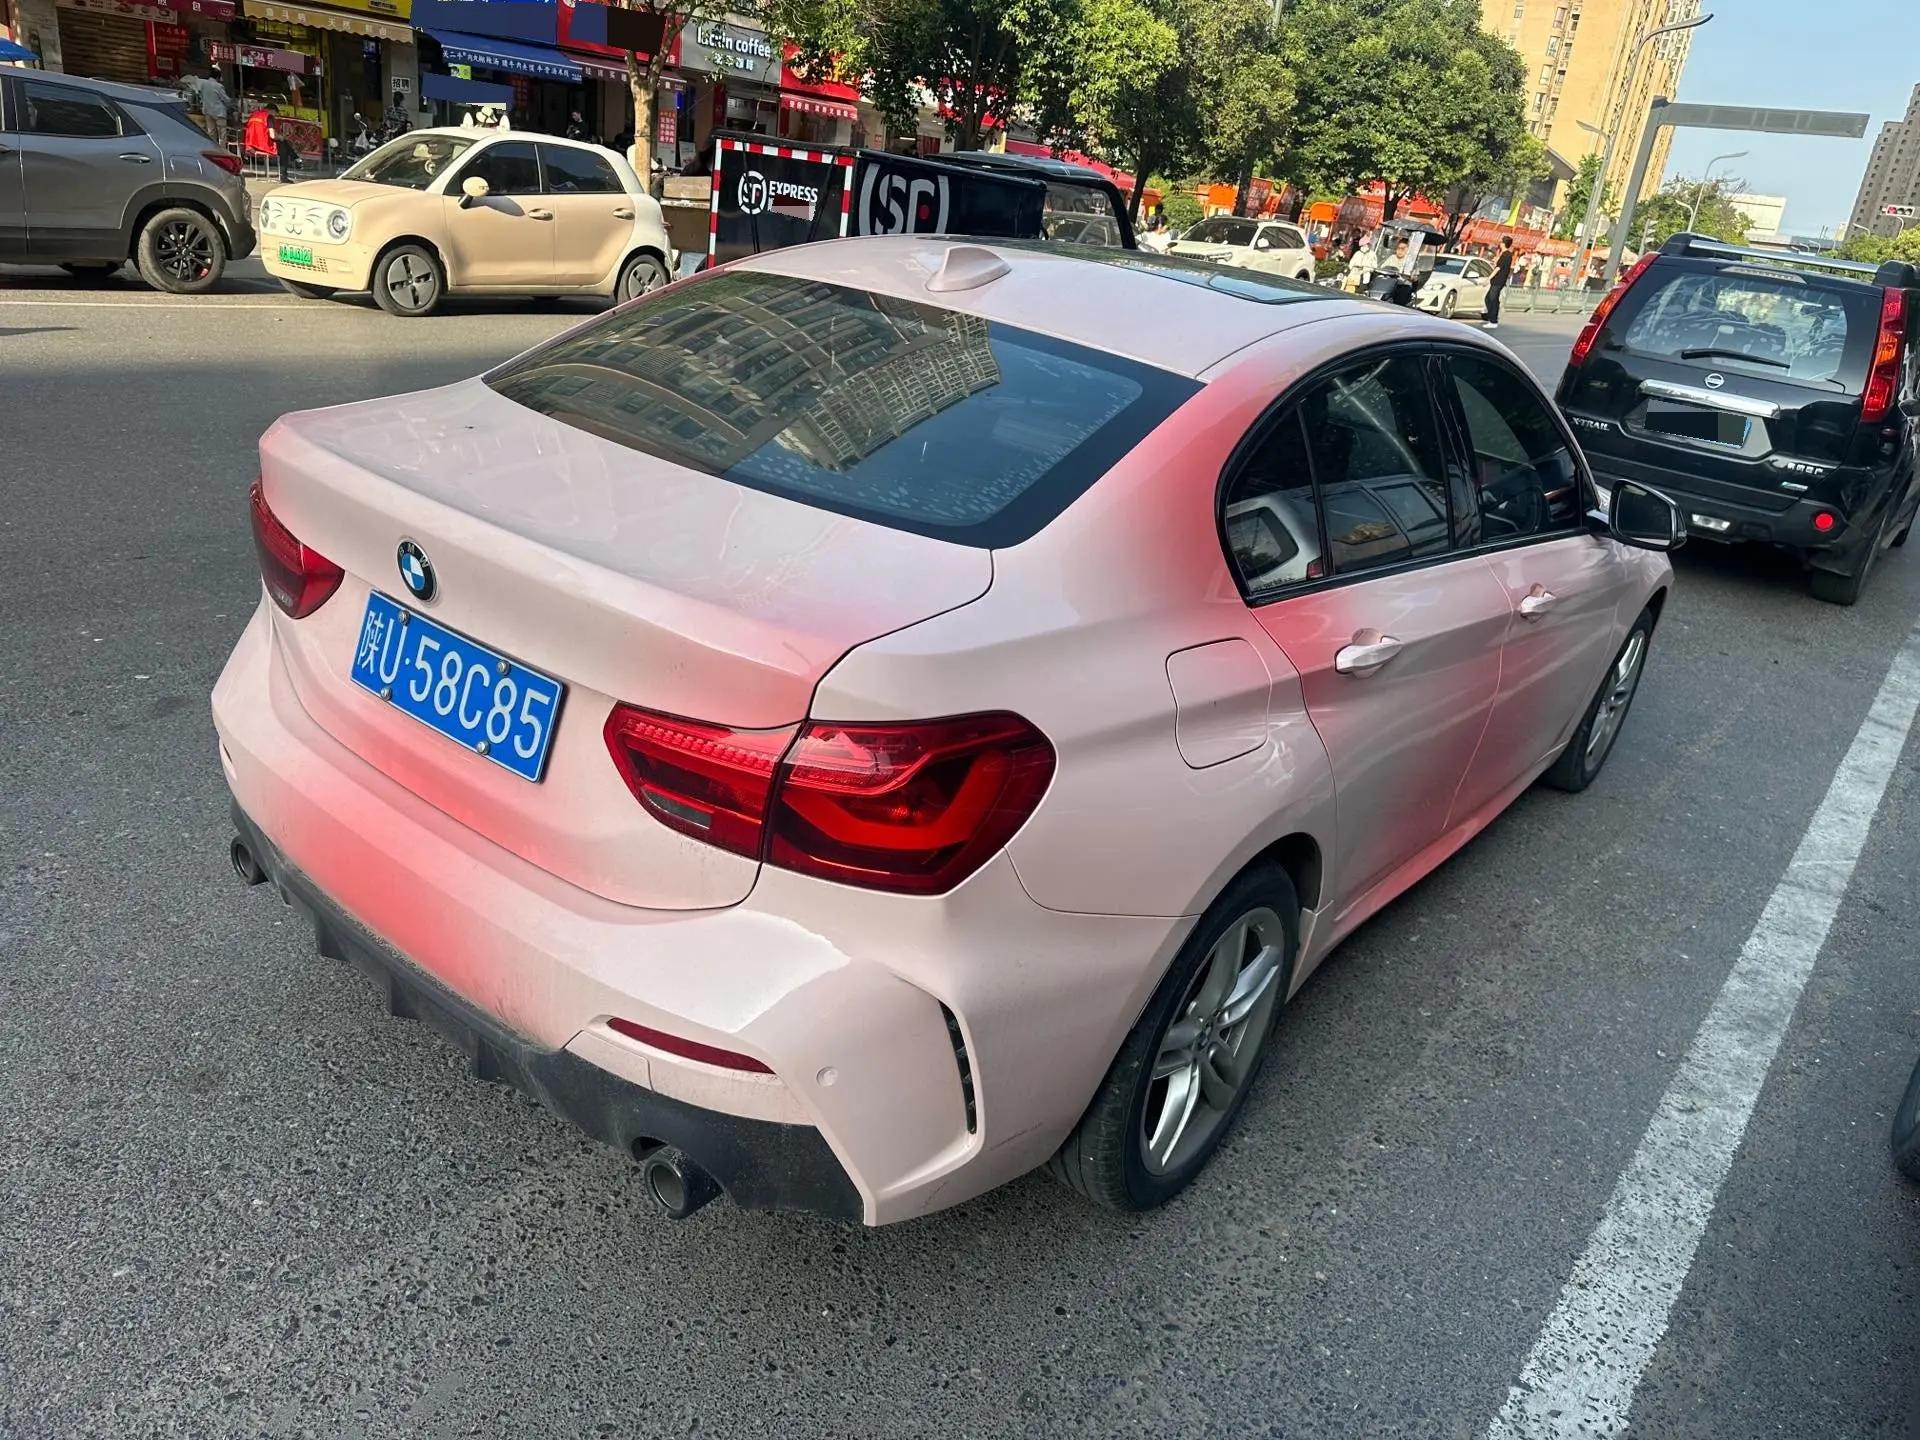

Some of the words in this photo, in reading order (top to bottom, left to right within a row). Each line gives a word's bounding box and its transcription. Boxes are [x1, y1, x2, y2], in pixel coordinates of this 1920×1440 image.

[736, 38, 771, 58] coffee
[392, 78, 410, 89] 招聘
[769, 180, 818, 203] EXPRESS
[1572, 416, 1611, 431] X-TRAIL
